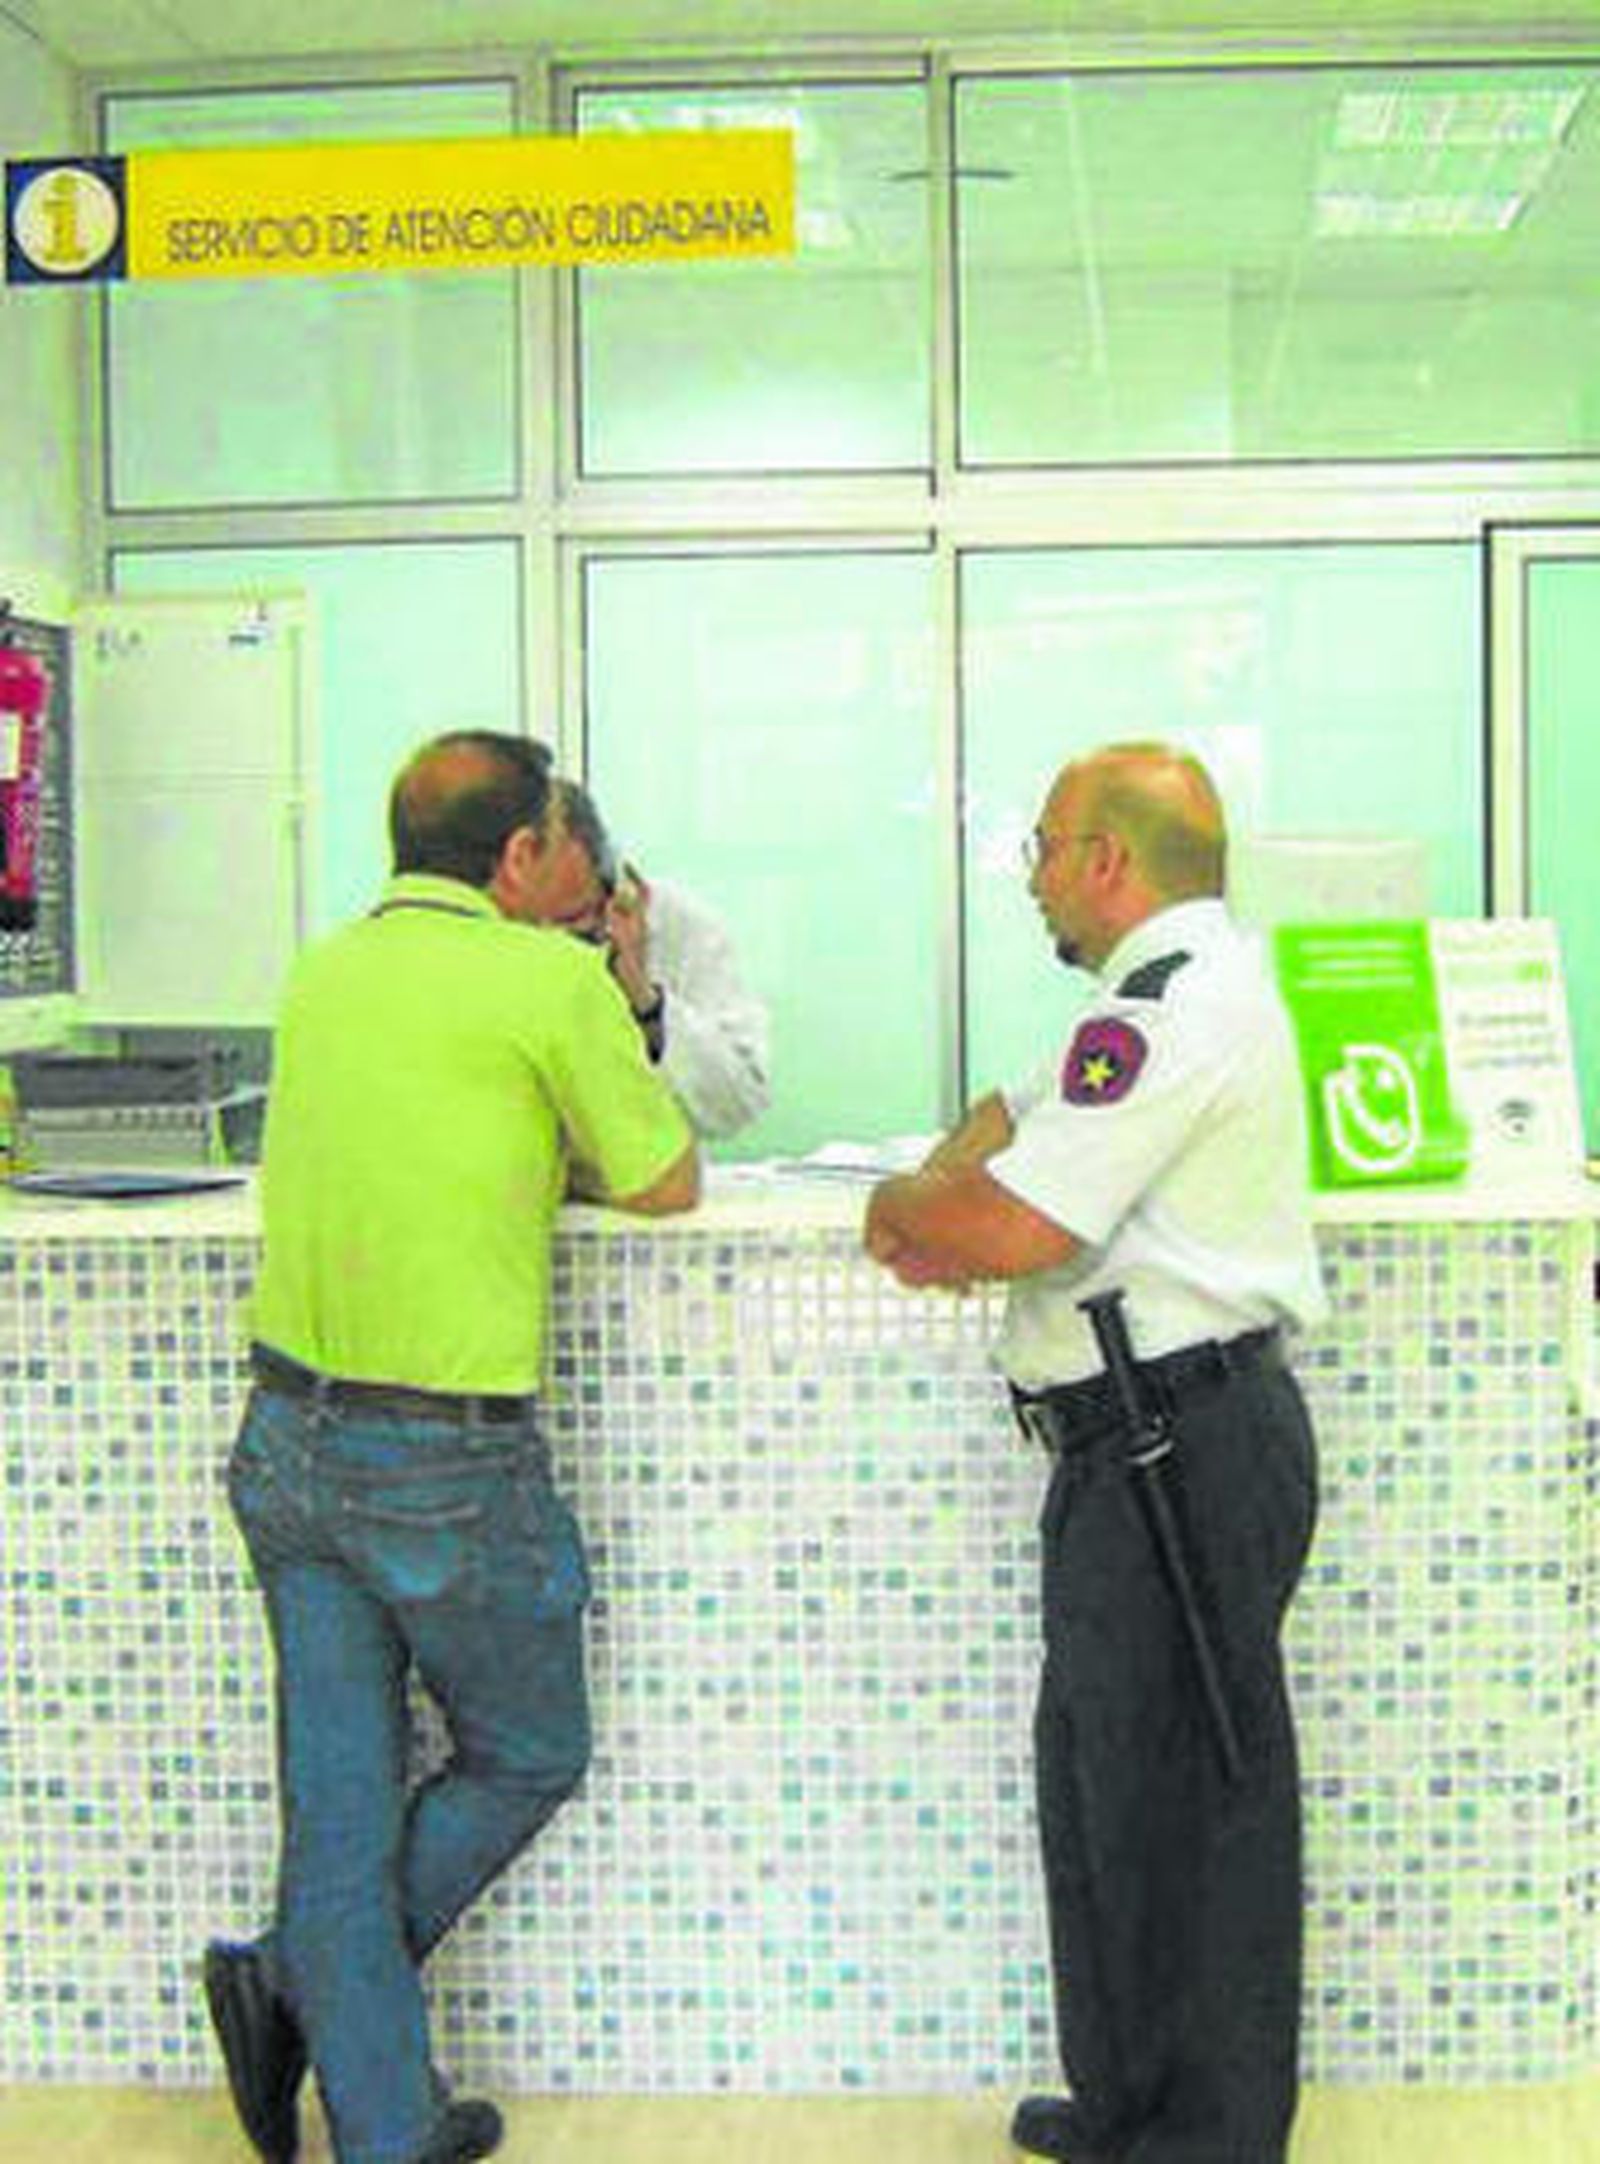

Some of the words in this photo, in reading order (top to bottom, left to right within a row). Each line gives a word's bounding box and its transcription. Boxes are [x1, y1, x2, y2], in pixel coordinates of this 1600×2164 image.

[166, 213, 320, 262] SERVICIO
[327, 211, 371, 258] DE
[565, 198, 773, 248] CIUDADANA
